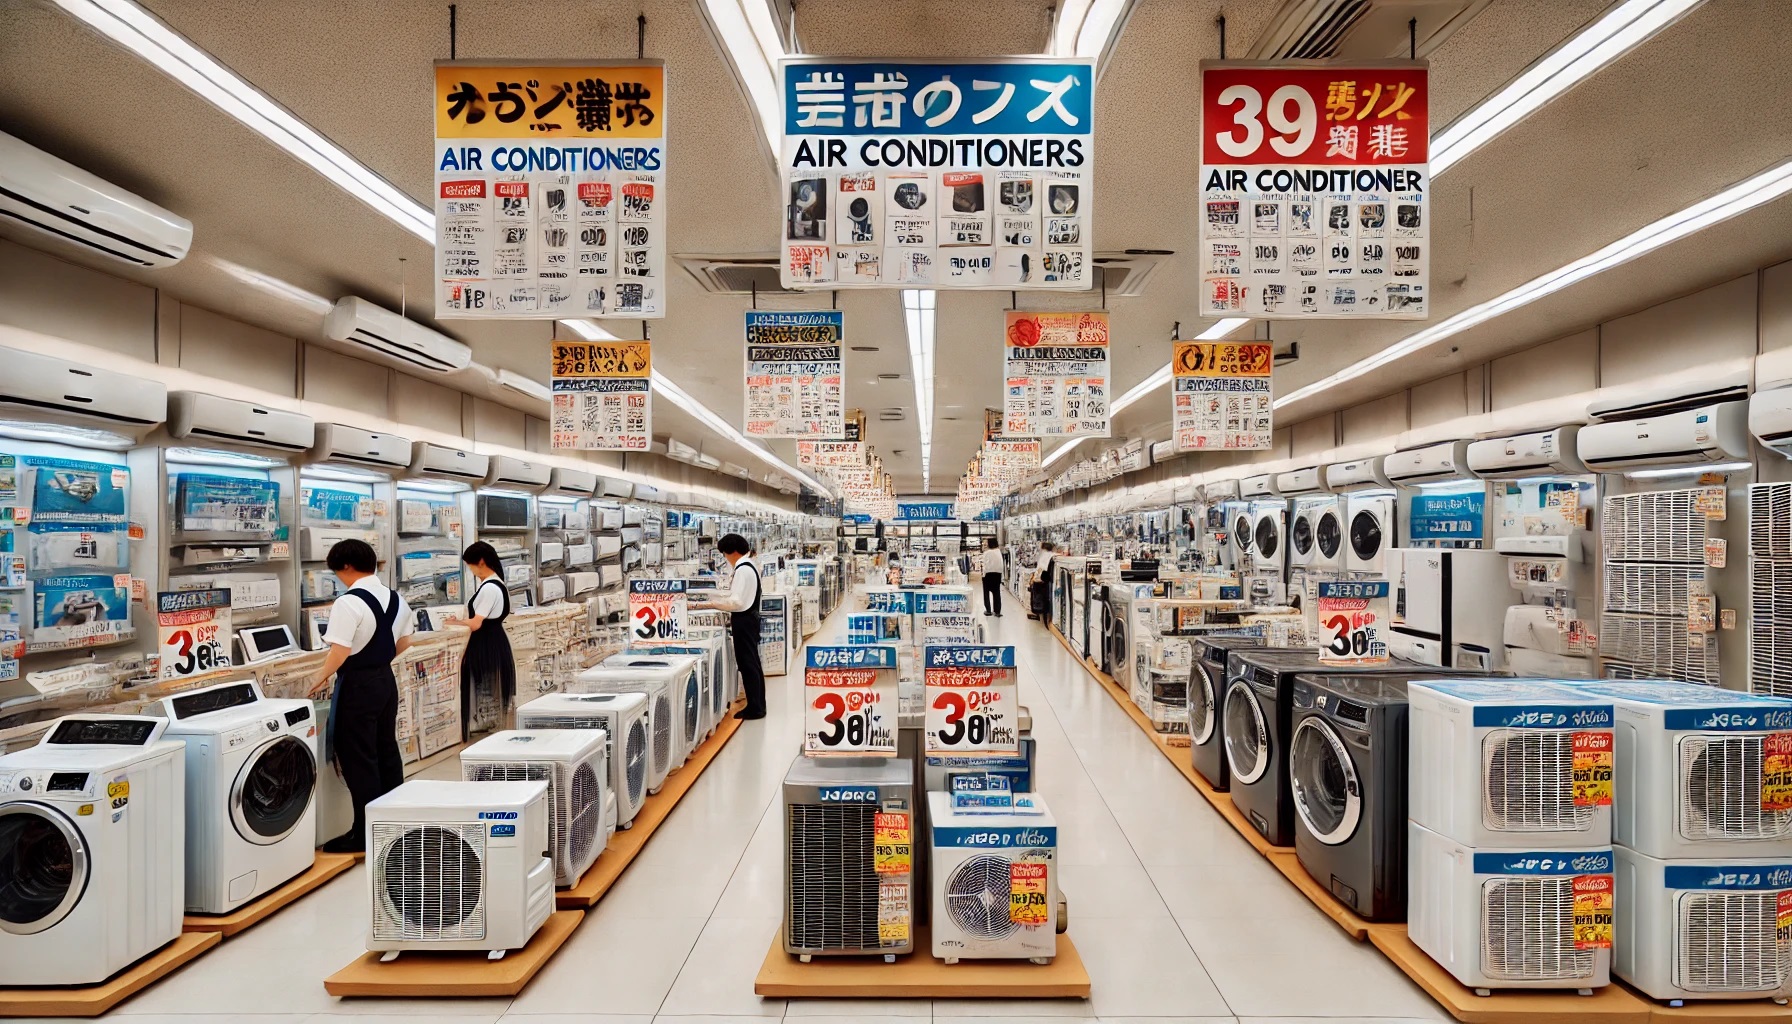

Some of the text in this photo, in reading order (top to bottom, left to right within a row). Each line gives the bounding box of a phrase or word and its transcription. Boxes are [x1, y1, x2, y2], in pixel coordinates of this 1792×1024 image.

[1215, 84, 1318, 158] 39
[440, 147, 661, 172] AIR CONDITIONERS
[792, 138, 1085, 168] AIR CONDITIONERS
[1205, 168, 1423, 193] AIR CONDITIONER
